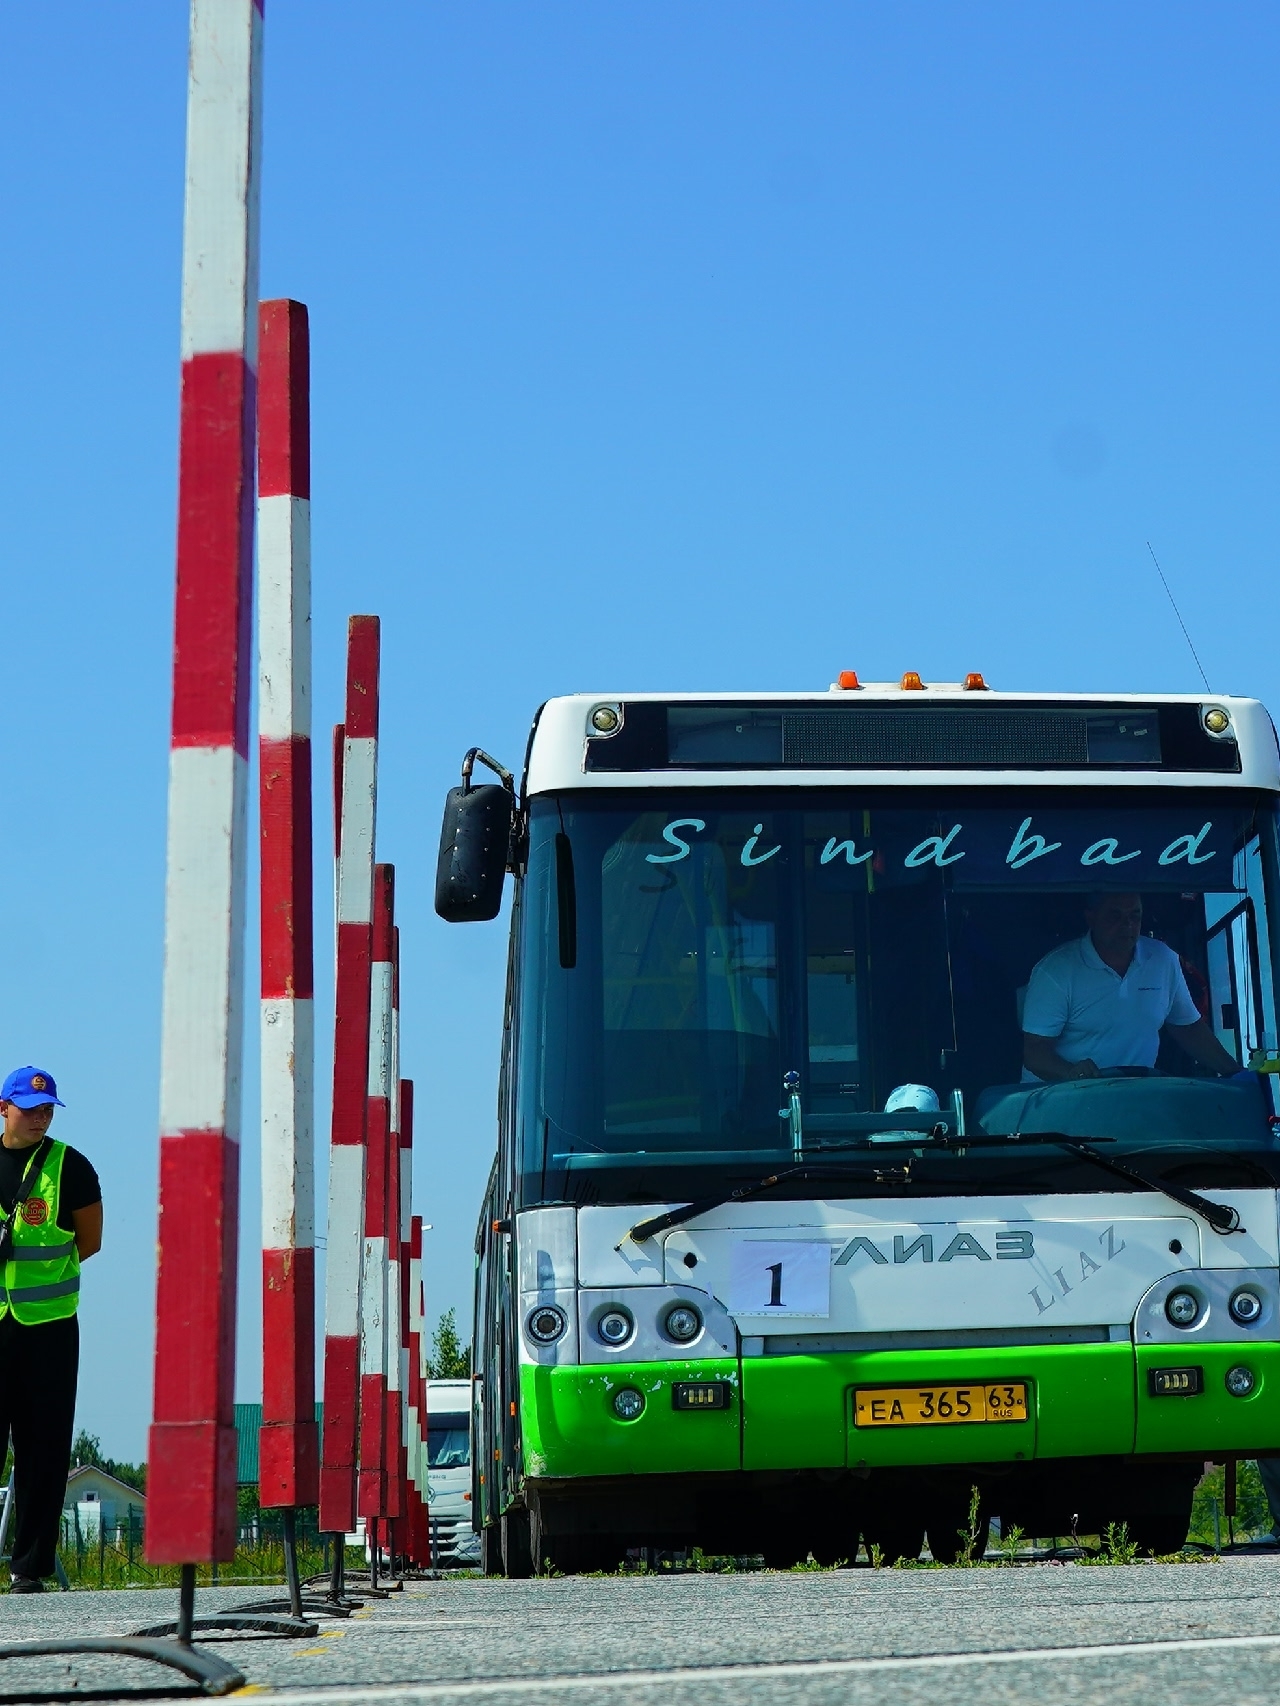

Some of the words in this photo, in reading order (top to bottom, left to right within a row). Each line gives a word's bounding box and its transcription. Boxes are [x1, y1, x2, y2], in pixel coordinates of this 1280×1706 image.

[645, 816, 1218, 869] Sindbad
[833, 1230, 1035, 1266] ЛИАЗ
[763, 1261, 788, 1307] 1
[1027, 1224, 1126, 1316] LIAZ
[871, 1400, 904, 1421] ЕА
[918, 1391, 971, 1418] 365
[988, 1387, 1015, 1408] 63
[993, 1409, 1013, 1418] RUS
